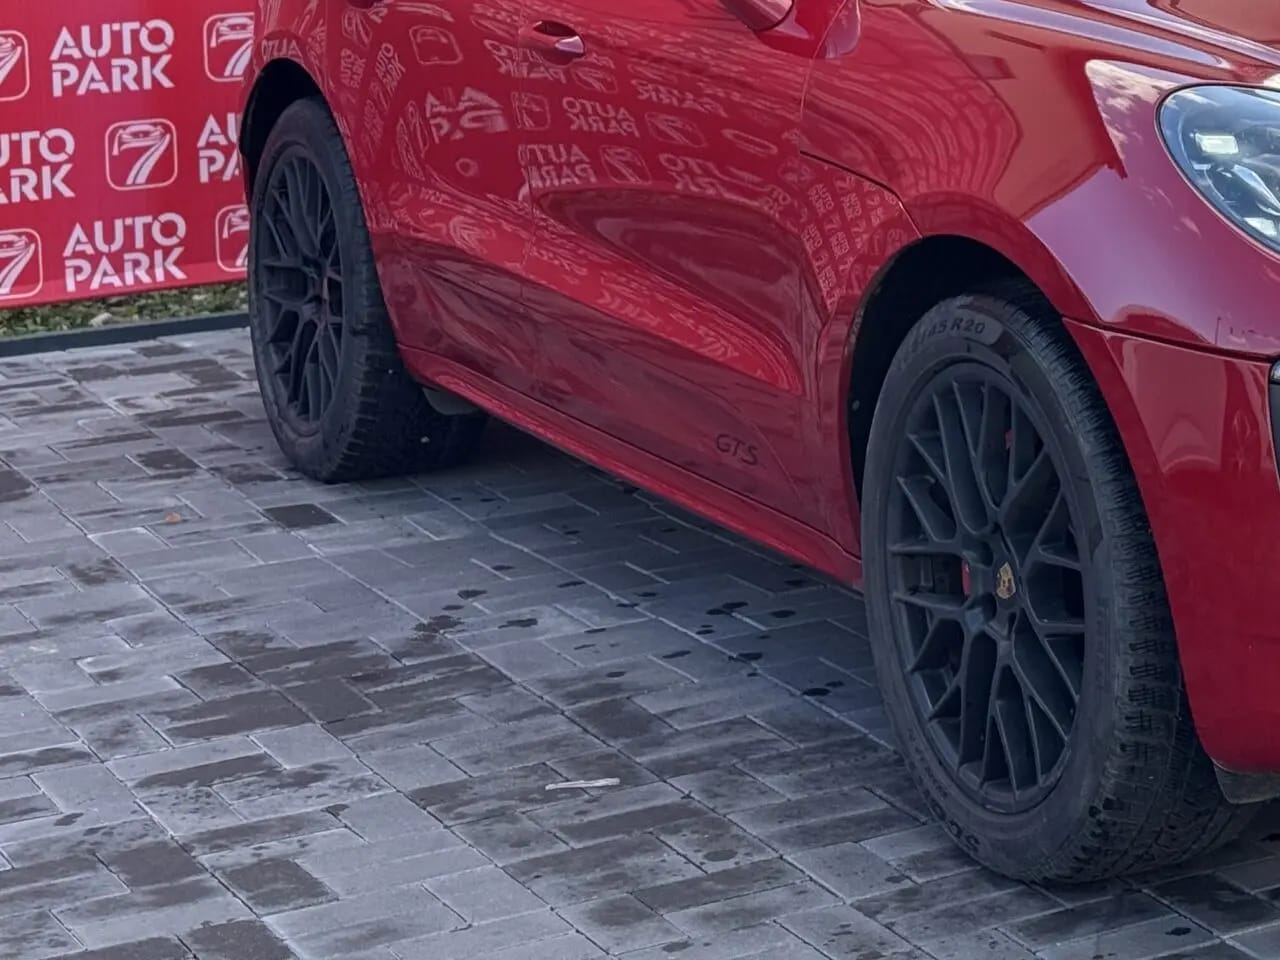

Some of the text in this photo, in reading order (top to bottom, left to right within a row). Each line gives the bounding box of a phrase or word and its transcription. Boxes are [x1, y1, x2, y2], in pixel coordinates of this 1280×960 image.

[50, 20, 173, 60] AUTO
[52, 55, 173, 96] PARK
[63, 213, 185, 256] AUTO
[65, 248, 186, 292] PARK
[716, 434, 759, 466] GTS
